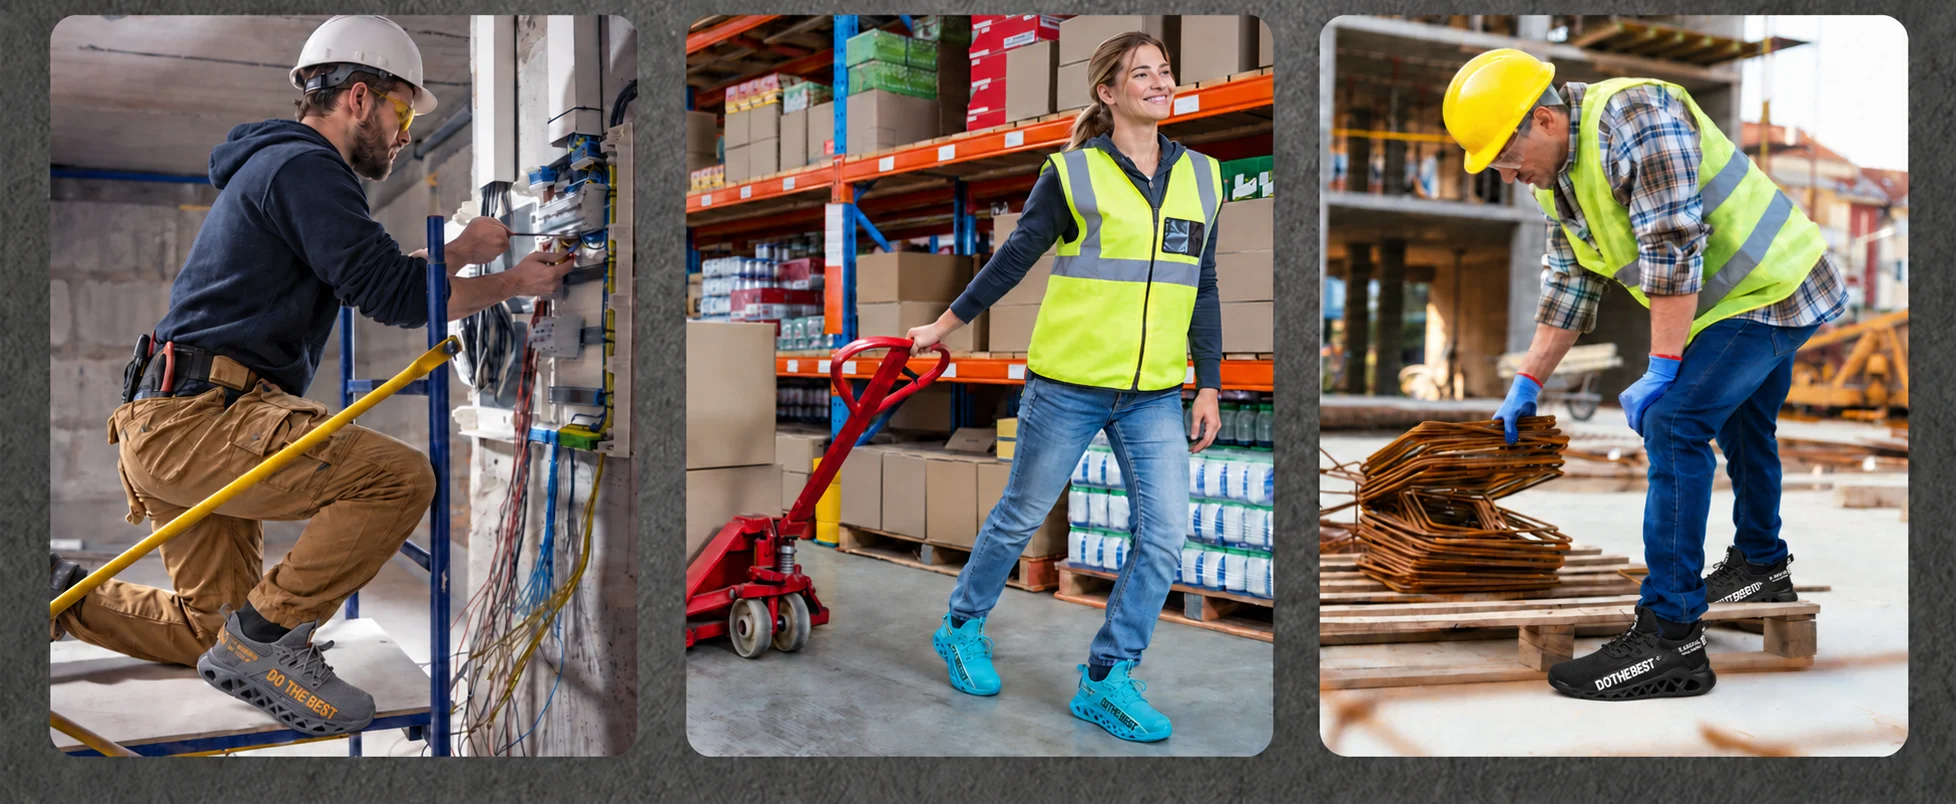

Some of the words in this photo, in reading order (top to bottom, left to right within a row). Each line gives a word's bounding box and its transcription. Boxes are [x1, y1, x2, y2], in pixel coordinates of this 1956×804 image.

[265, 668, 286, 687] DO
[285, 679, 310, 703] THE
[306, 695, 338, 720] BEST
[1595, 658, 1654, 691] DOTHEBEST
